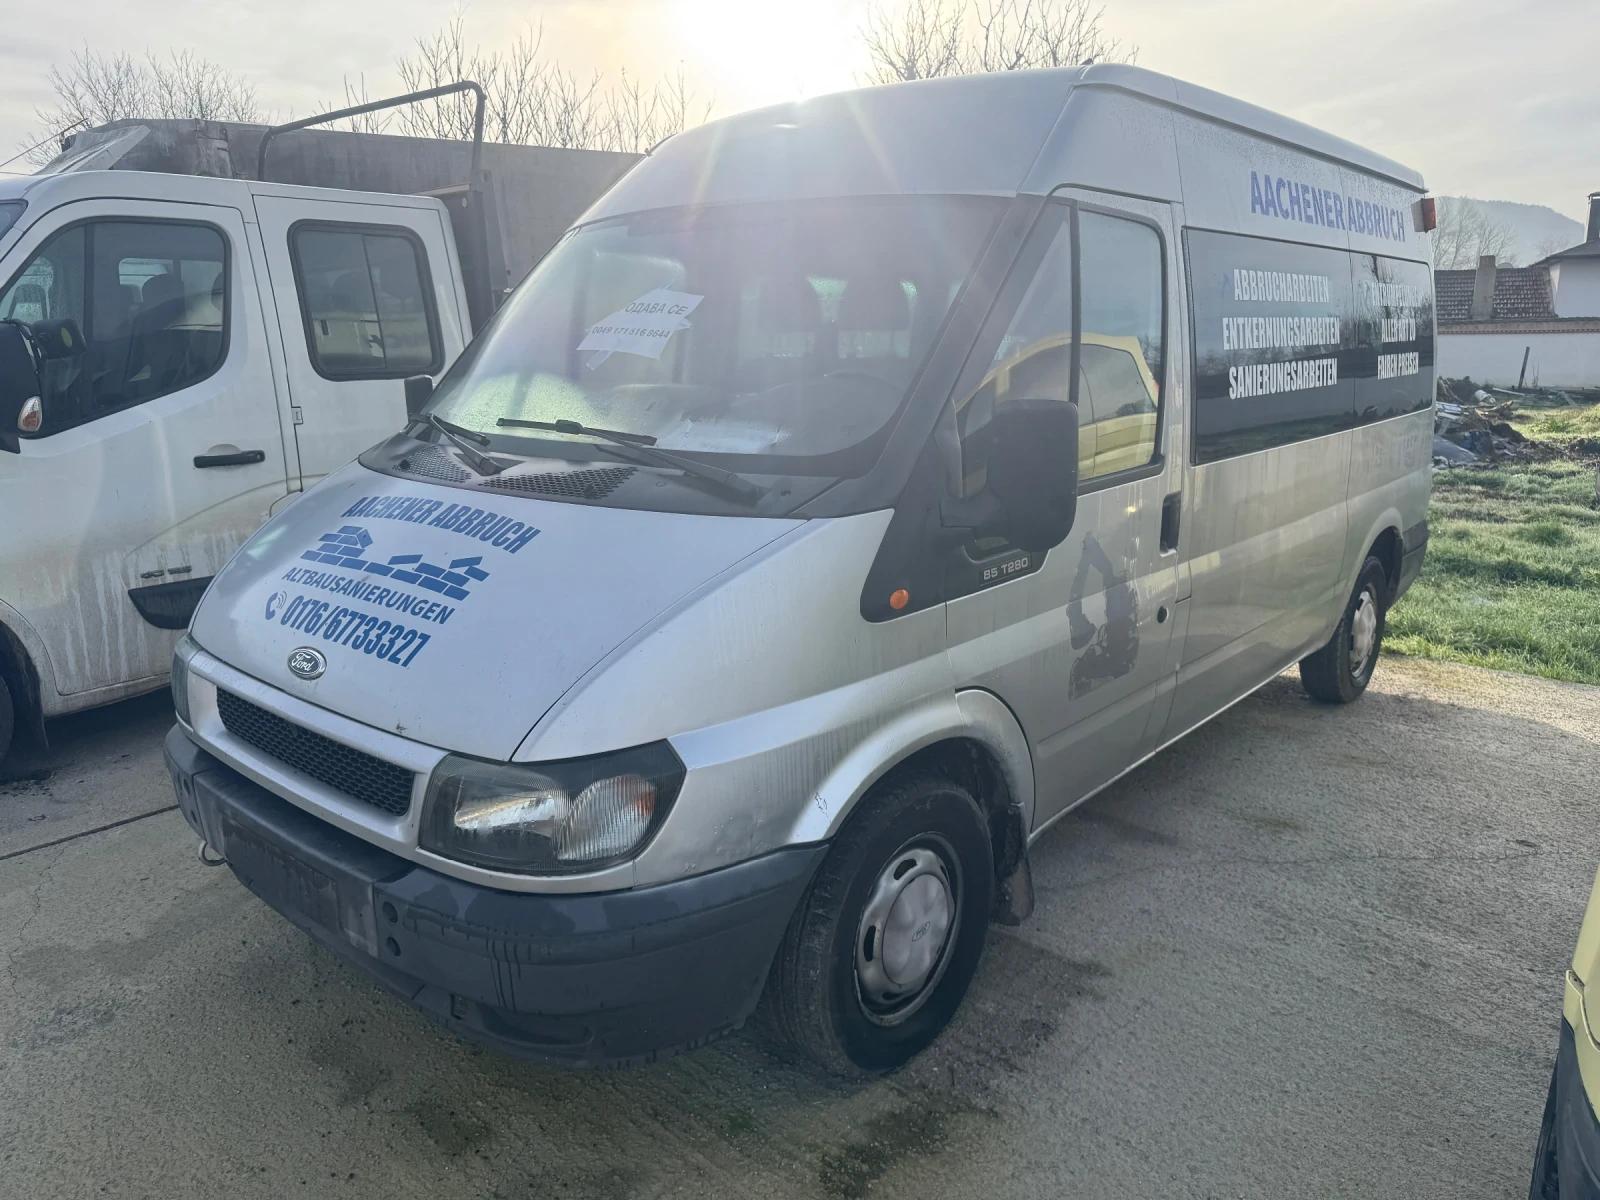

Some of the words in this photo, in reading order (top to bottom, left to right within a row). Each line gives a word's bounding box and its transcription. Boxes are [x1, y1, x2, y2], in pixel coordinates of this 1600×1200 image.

[1251, 170, 1346, 230] AACHENER
[1347, 196, 1405, 242] ABBRUCH
[1233, 269, 1330, 303] ABBRUCHARBEITEN
[625, 302, 666, 314] ОДАВА
[668, 304, 688, 315] СЕ
[592, 326, 613, 334] 0049
[1222, 317, 1340, 350] ENTKERNUNGSARBEITEN
[1229, 358, 1337, 400] SANIERUNGSARBEITEN
[1378, 353, 1397, 380] FAIREN
[340, 496, 441, 525] AACHENER
[431, 503, 541, 554] ABBRUCH
[983, 567, 998, 581] 85
[1001, 557, 1029, 575] T280
[282, 567, 455, 625] ALTBAUSANIERUNGEN
[280, 595, 431, 668] 0176/67733327
